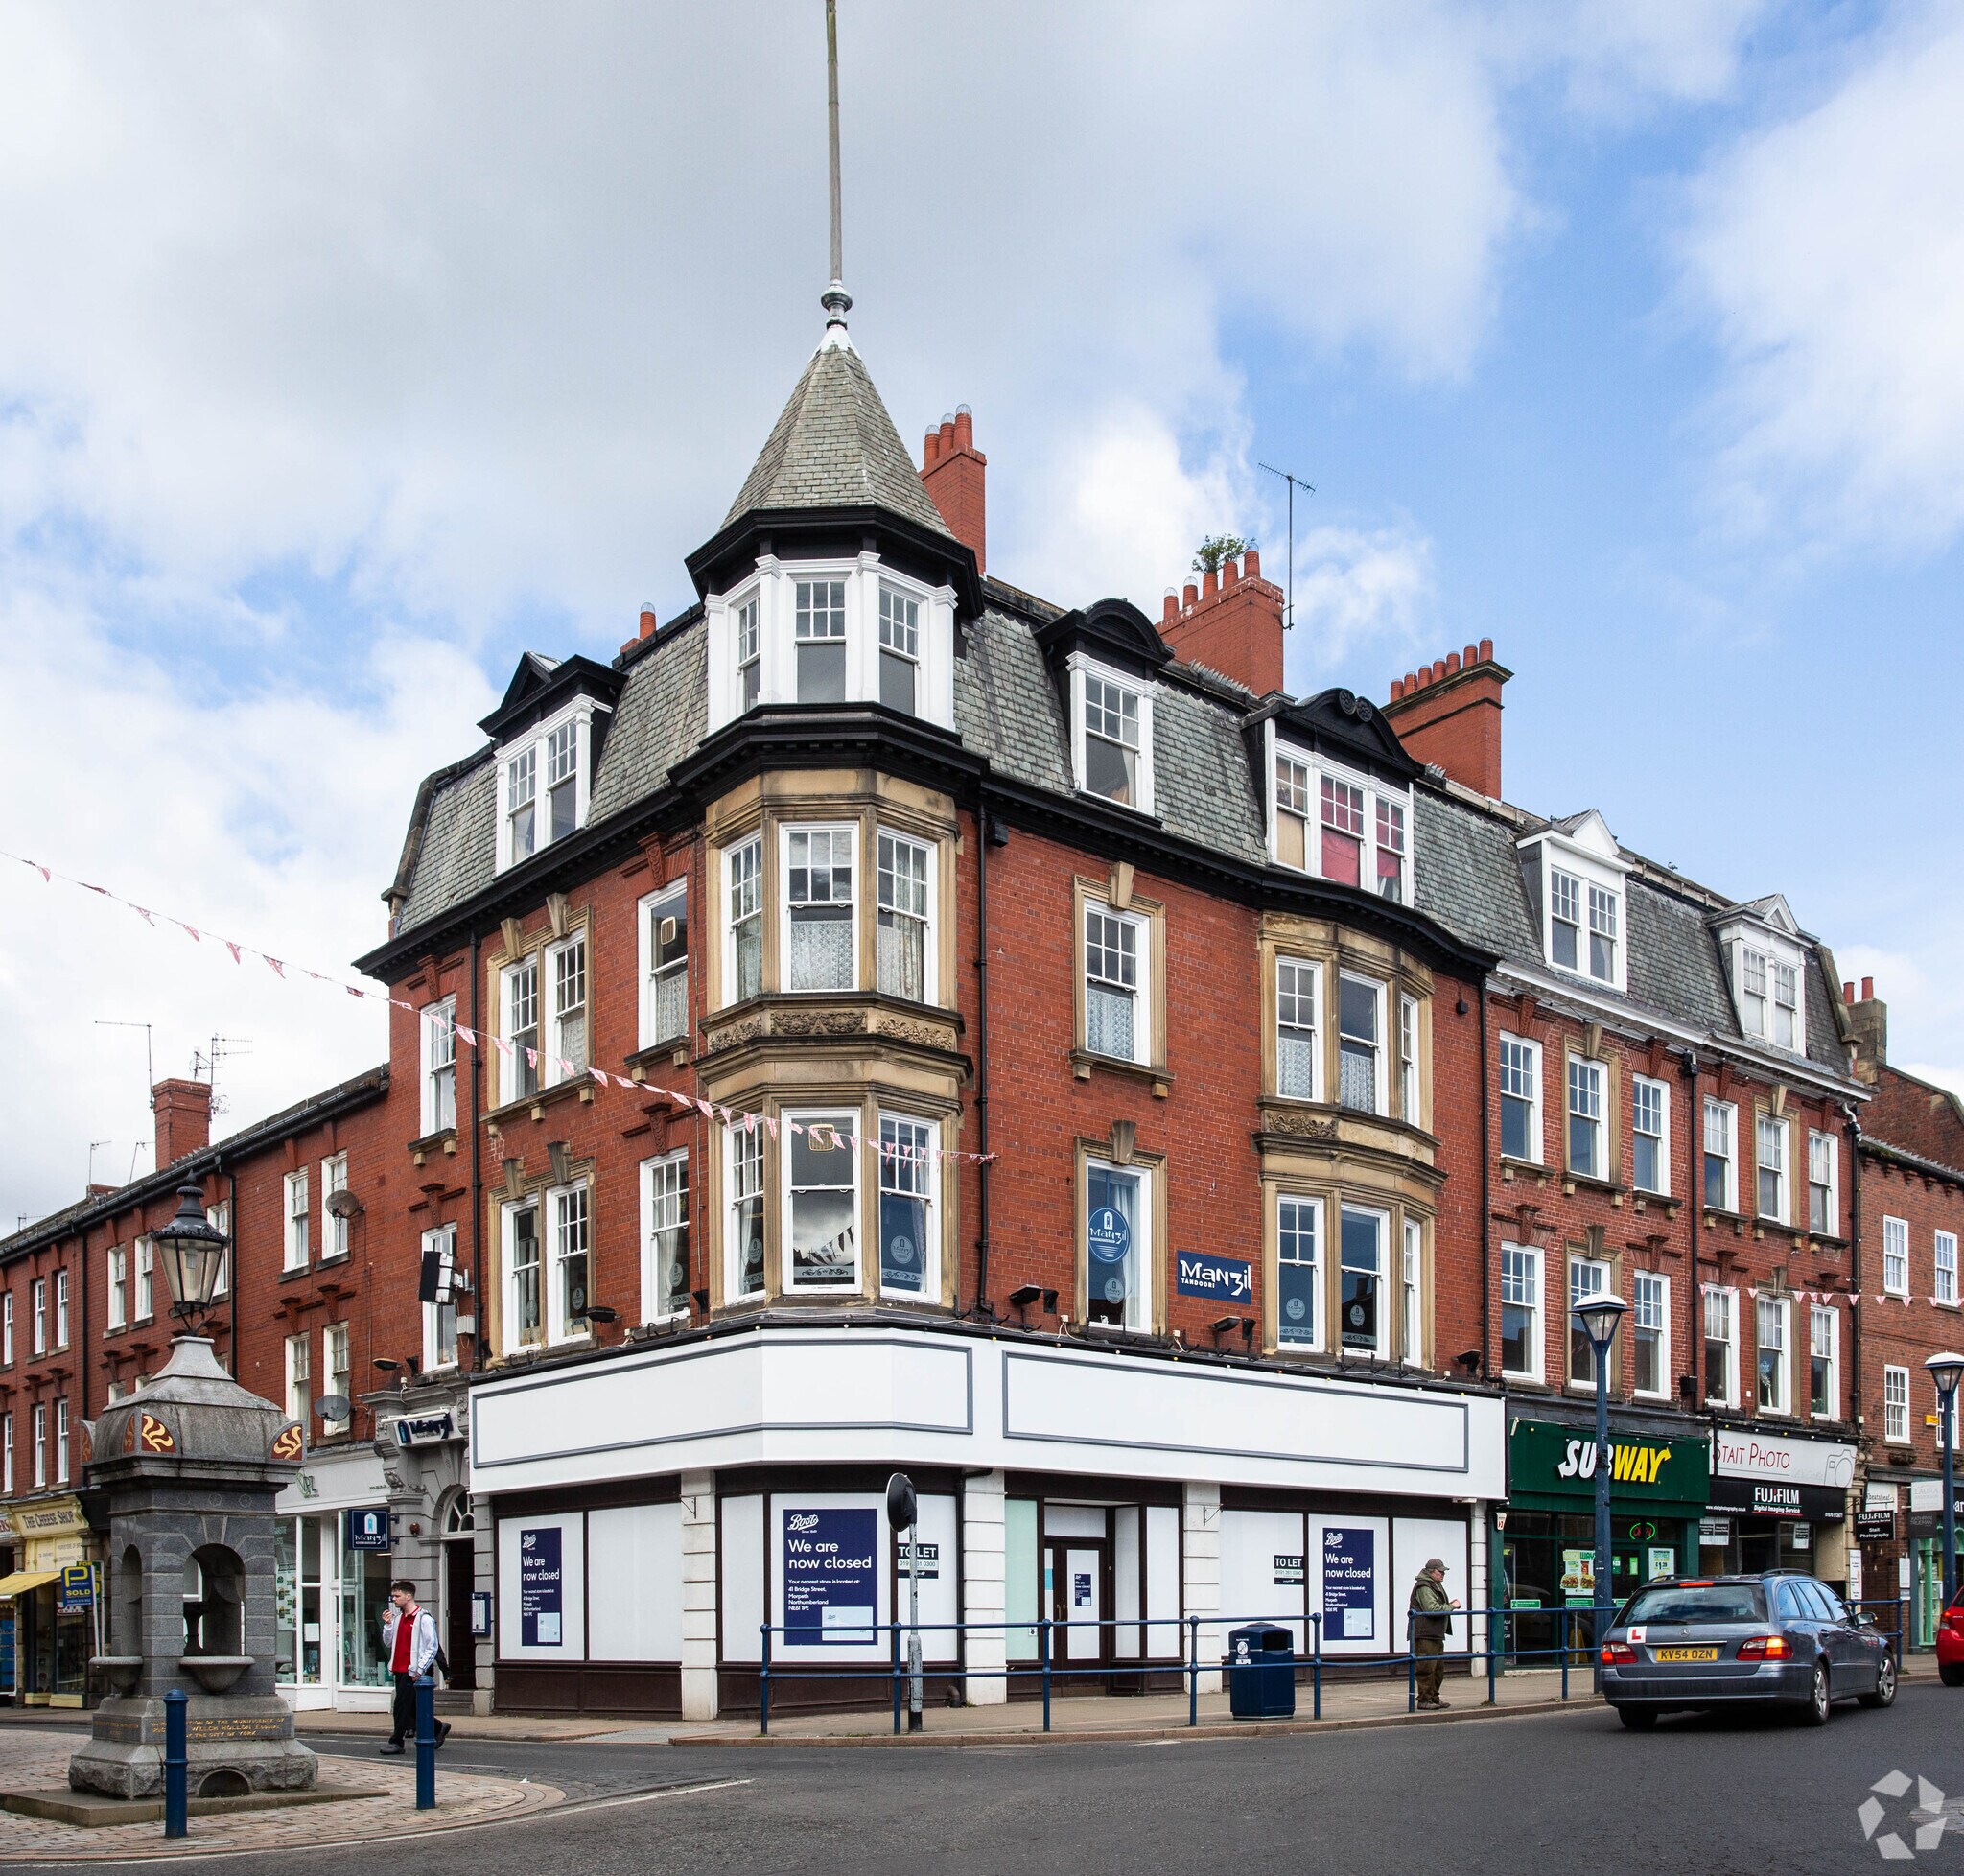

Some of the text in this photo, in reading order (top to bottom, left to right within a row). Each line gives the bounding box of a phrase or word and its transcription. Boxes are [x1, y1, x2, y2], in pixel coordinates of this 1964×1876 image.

[1181, 1278, 1214, 1288] TANDOORI
[1749, 1442, 1789, 1468] PHOTO
[1755, 1487, 1799, 1504] FUJIFILM
[22, 1511, 74, 1528] THE CHEESE SHOP
[788, 1539, 838, 1552] We are
[917, 1547, 936, 1558] LET
[523, 1556, 545, 1566] We are
[789, 1556, 872, 1568] now closed
[1275, 1558, 1302, 1567] TO LET
[1325, 1553, 1353, 1564] We are
[538, 1568, 560, 1580] closed
[1325, 1567, 1371, 1578] now closed
[1632, 1629, 1641, 1640] L
[1661, 1649, 1713, 1659] KV54 OZN
